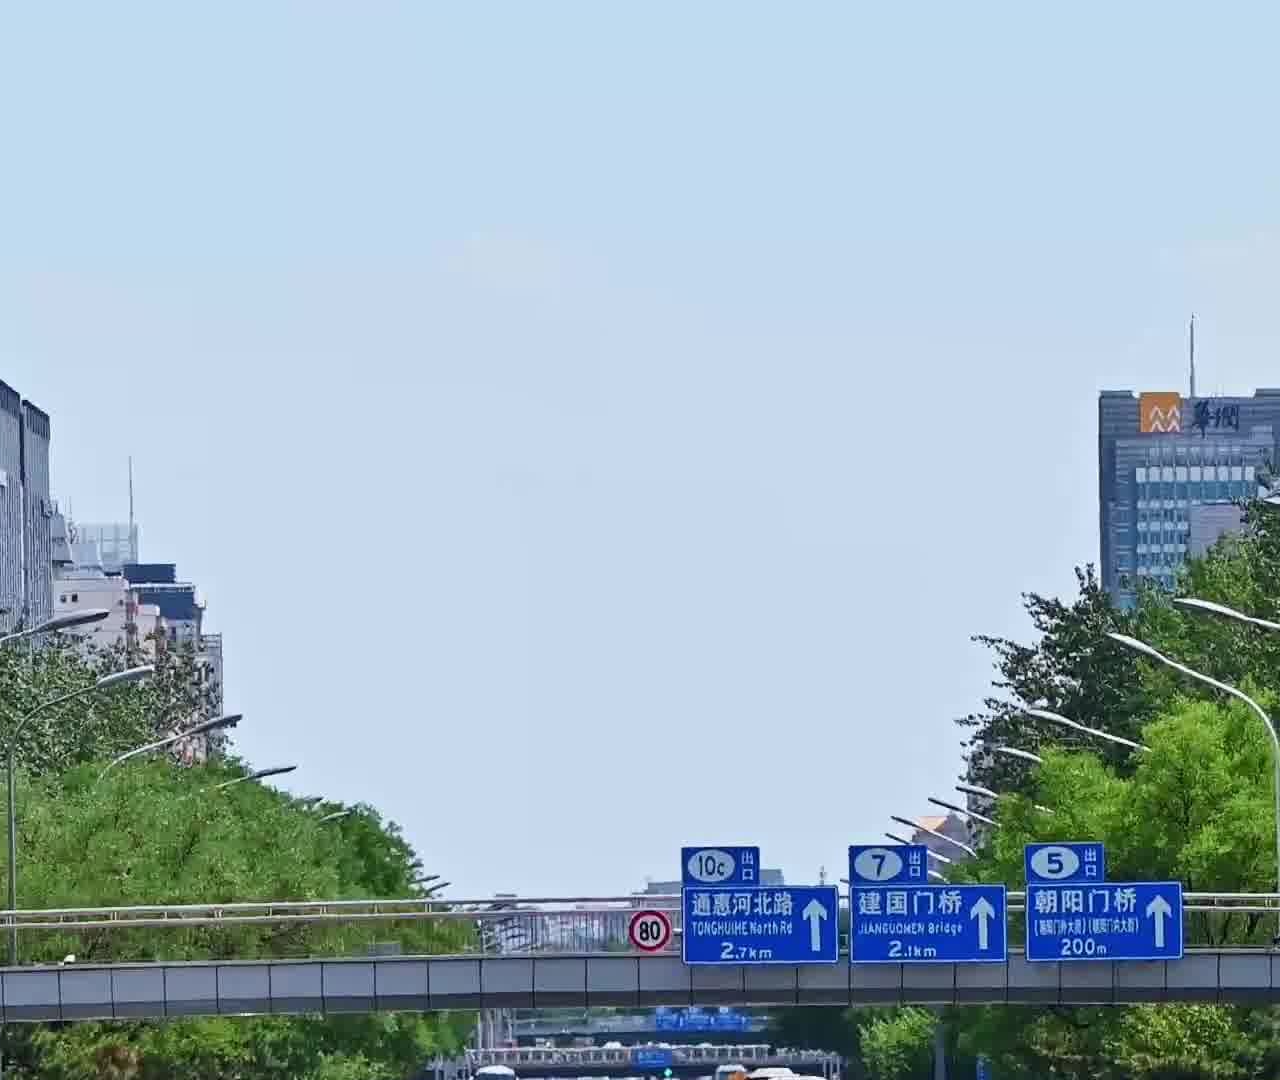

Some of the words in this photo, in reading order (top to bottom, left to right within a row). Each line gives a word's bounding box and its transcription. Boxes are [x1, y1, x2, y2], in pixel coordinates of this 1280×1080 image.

[741, 851, 754, 881] 出口
[871, 854, 886, 878] 7
[908, 851, 921, 877] 出口
[1047, 852, 1064, 874] 5
[1084, 848, 1097, 877] 出口
[691, 891, 793, 916] 通惠河北路
[858, 890, 962, 915] 建国门桥
[1034, 888, 1137, 913] 朝阳门桥
[639, 920, 661, 941] 80
[749, 920, 778, 936] North
[780, 920, 793, 936] Rd
[928, 921, 962, 937] Bridge
[720, 942, 773, 960] 2.7km
[887, 940, 937, 958] 2.1km
[1060, 938, 1107, 956] 200m
